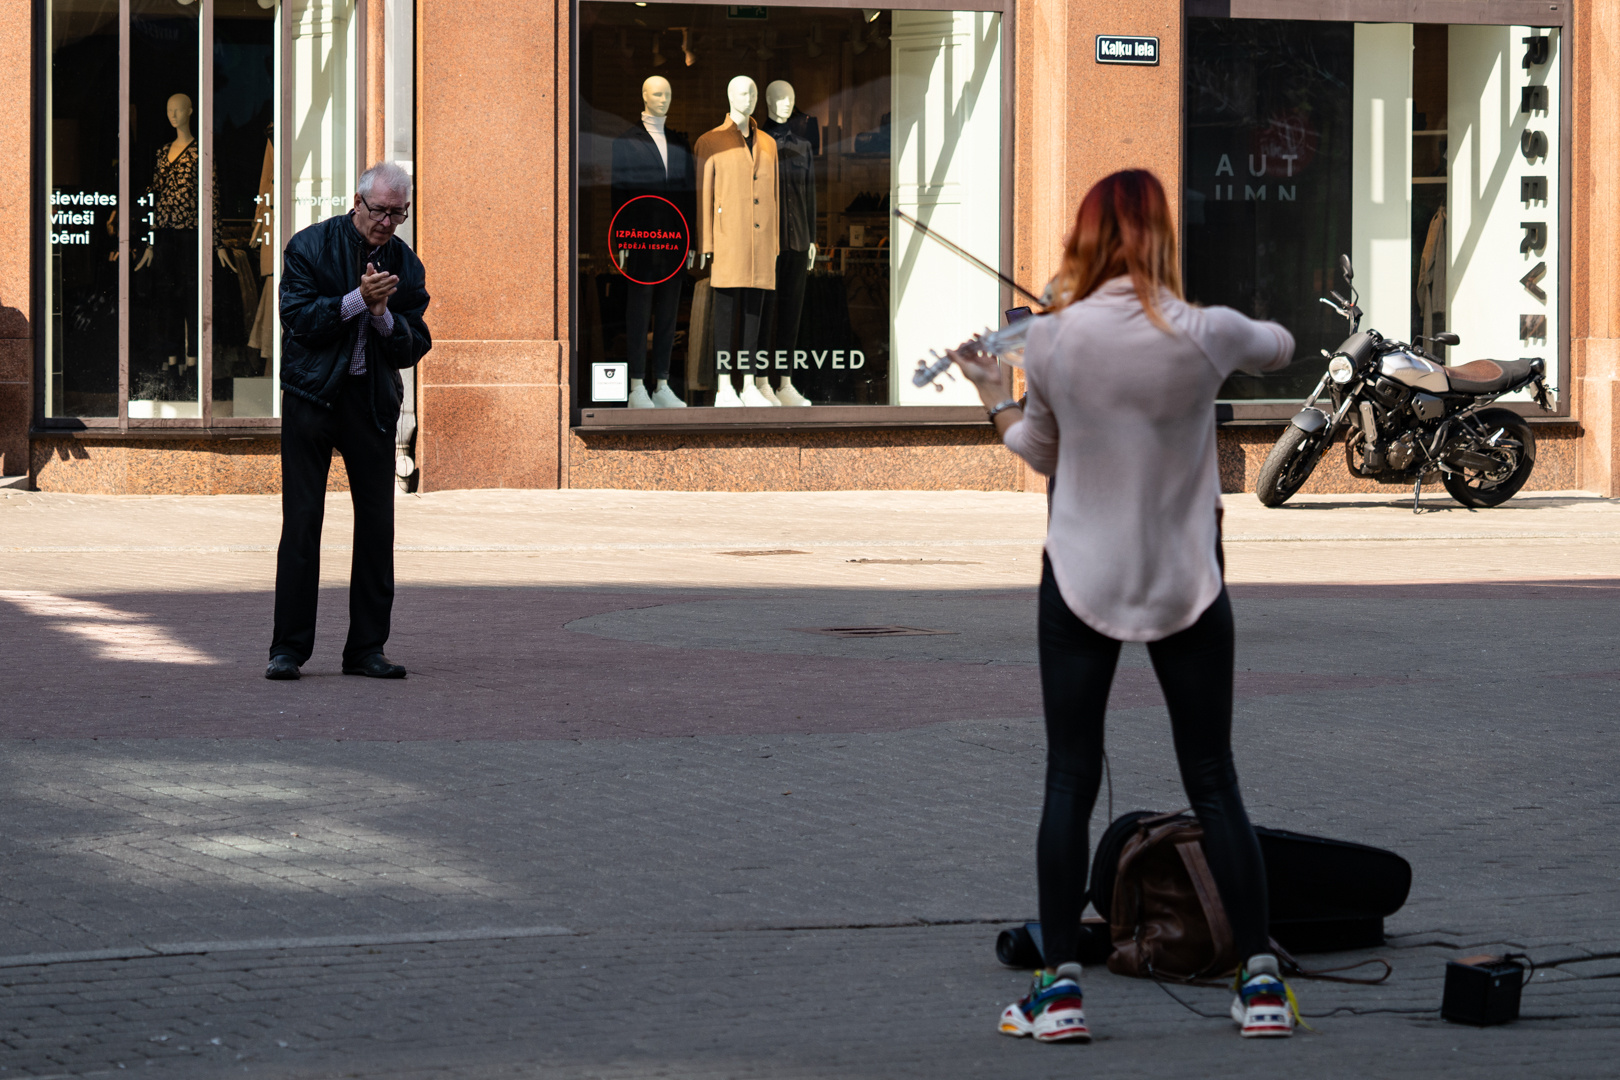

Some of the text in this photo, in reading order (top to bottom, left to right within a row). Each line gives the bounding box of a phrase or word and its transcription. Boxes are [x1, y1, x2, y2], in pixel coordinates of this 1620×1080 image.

[1215, 153, 1298, 177] AUT
[50, 191, 154, 207] sievietes +1
[254, 193, 270, 206] +1
[1519, 36, 1549, 362] RESERVE
[50, 210, 154, 226] vīrieši -1
[256, 212, 270, 226] -1
[50, 230, 154, 245] bērni -1
[256, 231, 270, 246] -1
[615, 228, 682, 239] IZPĀRDOŠANA
[716, 349, 866, 370] RESERVED
